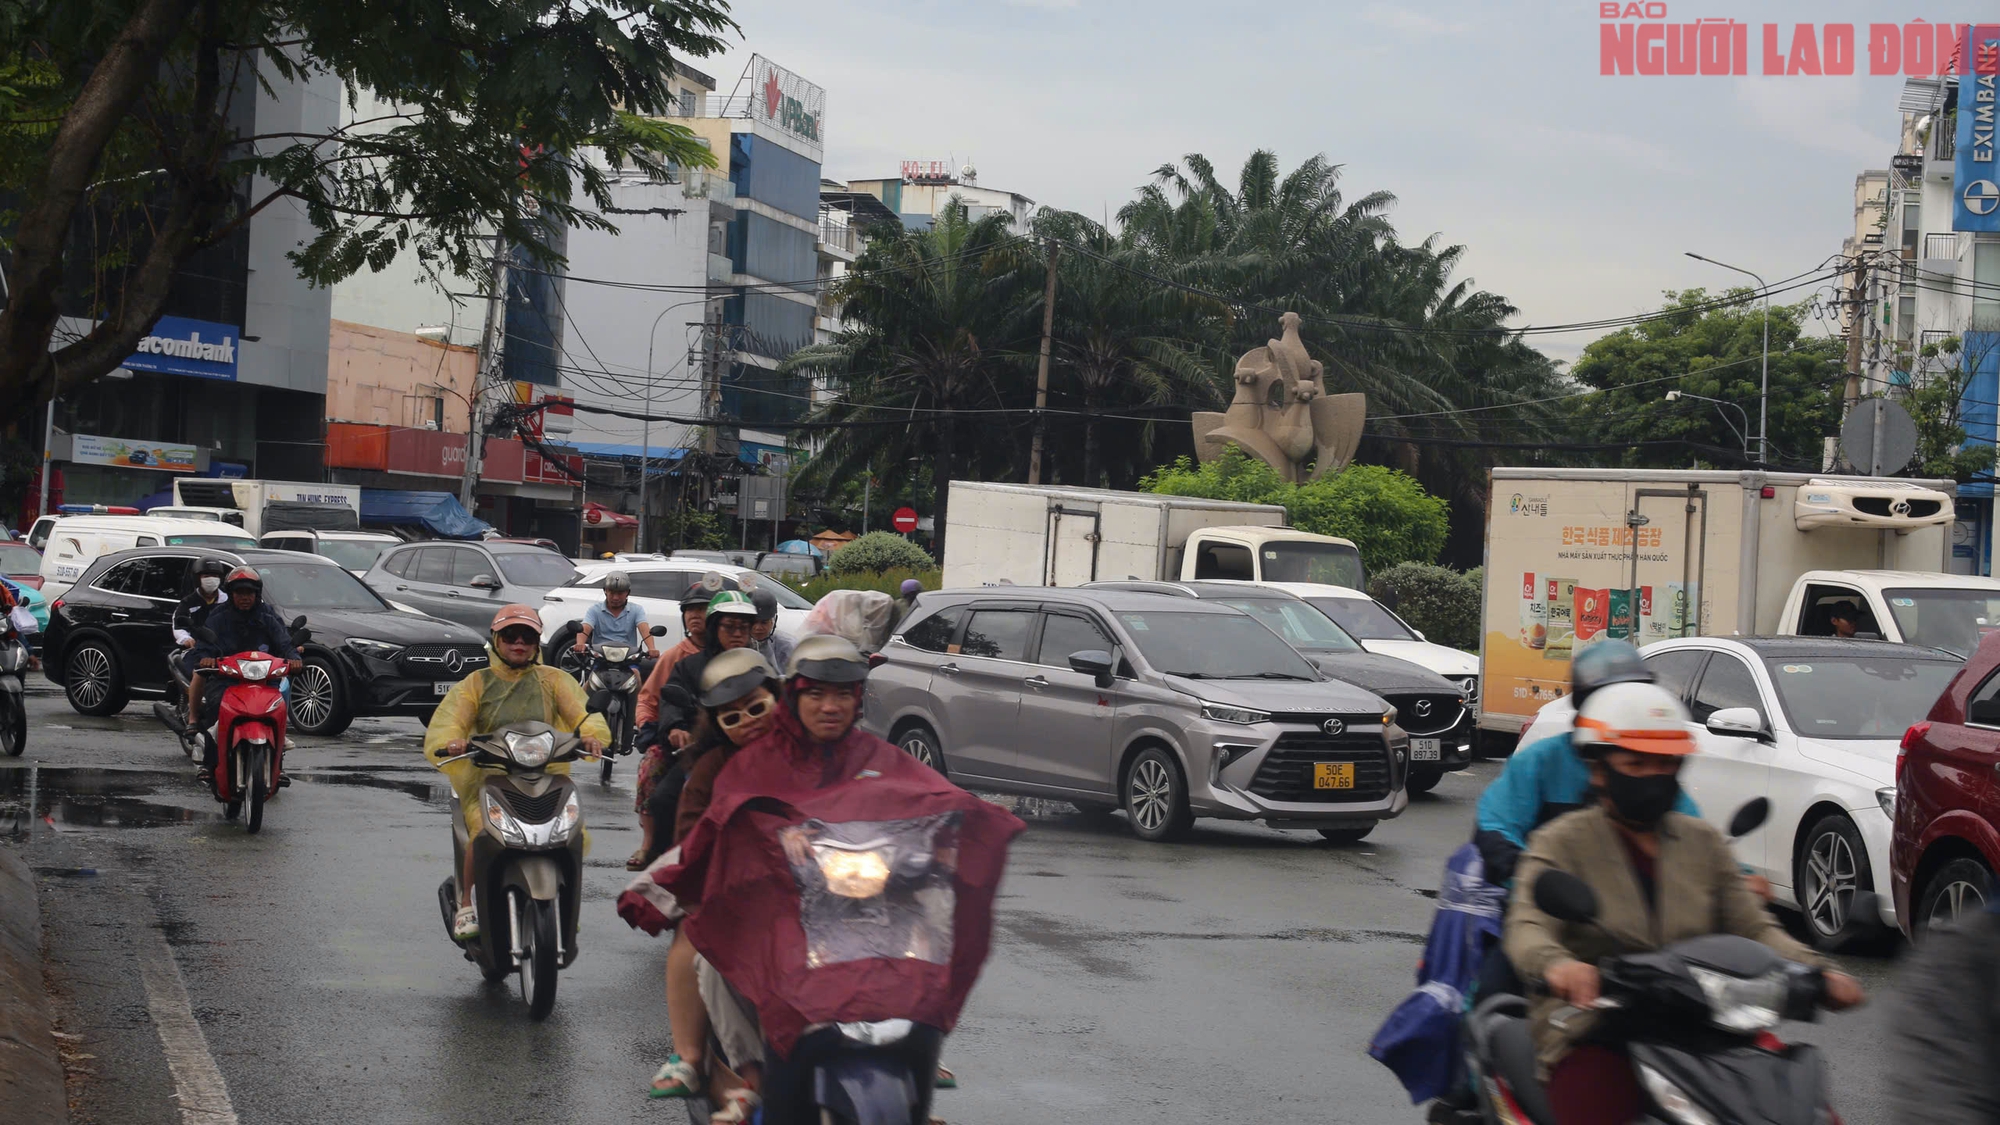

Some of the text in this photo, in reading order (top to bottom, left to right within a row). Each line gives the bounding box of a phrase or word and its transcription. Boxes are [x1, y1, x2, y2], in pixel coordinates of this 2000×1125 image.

[1973, 41, 1998, 162] EXIMBANK
[781, 93, 820, 142] VPBank
[137, 331, 235, 363] acombank
[1521, 503, 1548, 517] 산내들
[1562, 526, 1585, 546] 한국
[1587, 527, 1610, 547] 식품
[1419, 741, 1432, 750] 51D
[1413, 750, 1438, 760] 897.39
[1326, 764, 1343, 776] 50E
[1318, 776, 1350, 788] 047.66
